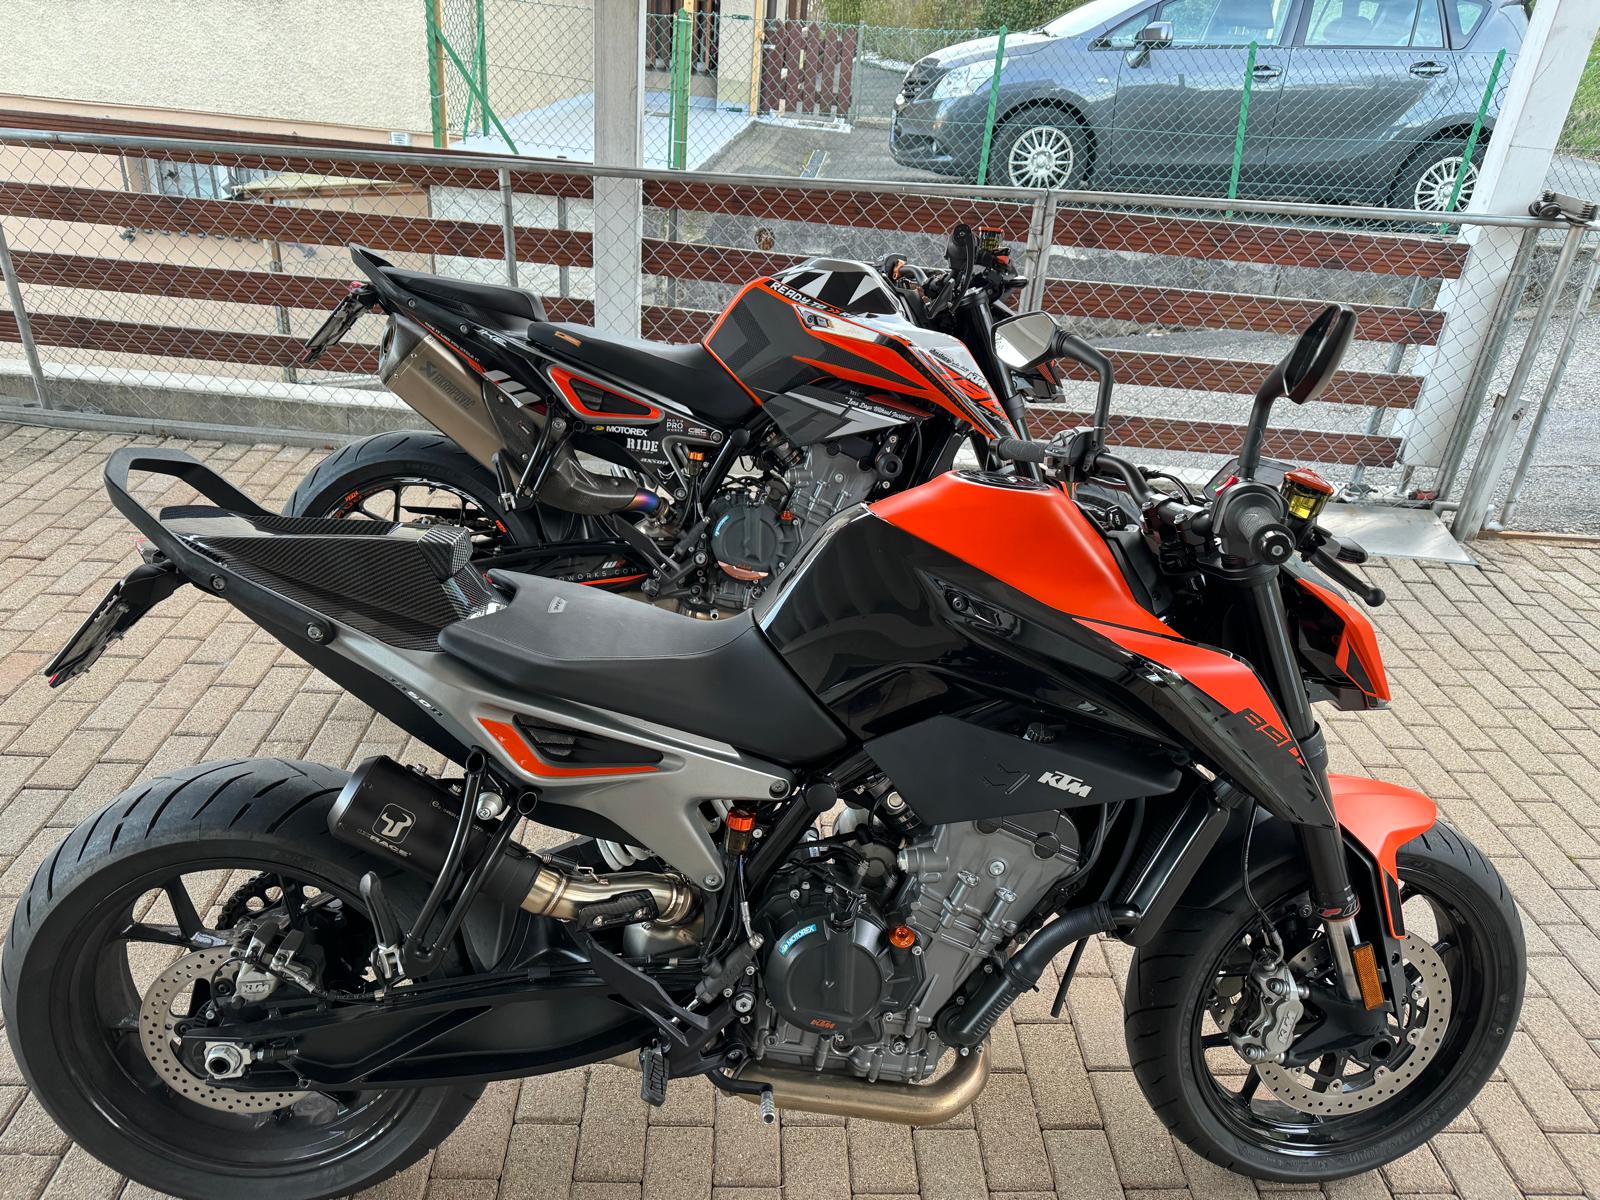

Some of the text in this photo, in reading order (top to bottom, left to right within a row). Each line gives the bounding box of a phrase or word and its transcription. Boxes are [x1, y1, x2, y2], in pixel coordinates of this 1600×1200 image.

[769, 281, 828, 311] READY TO
[606, 425, 649, 437] MOTOREX
[666, 421, 684, 430] PRO
[626, 437, 659, 453] RIDE
[1037, 770, 1093, 798] KTM
[786, 924, 816, 947] MOTOREX
[241, 982, 271, 994] KTM
